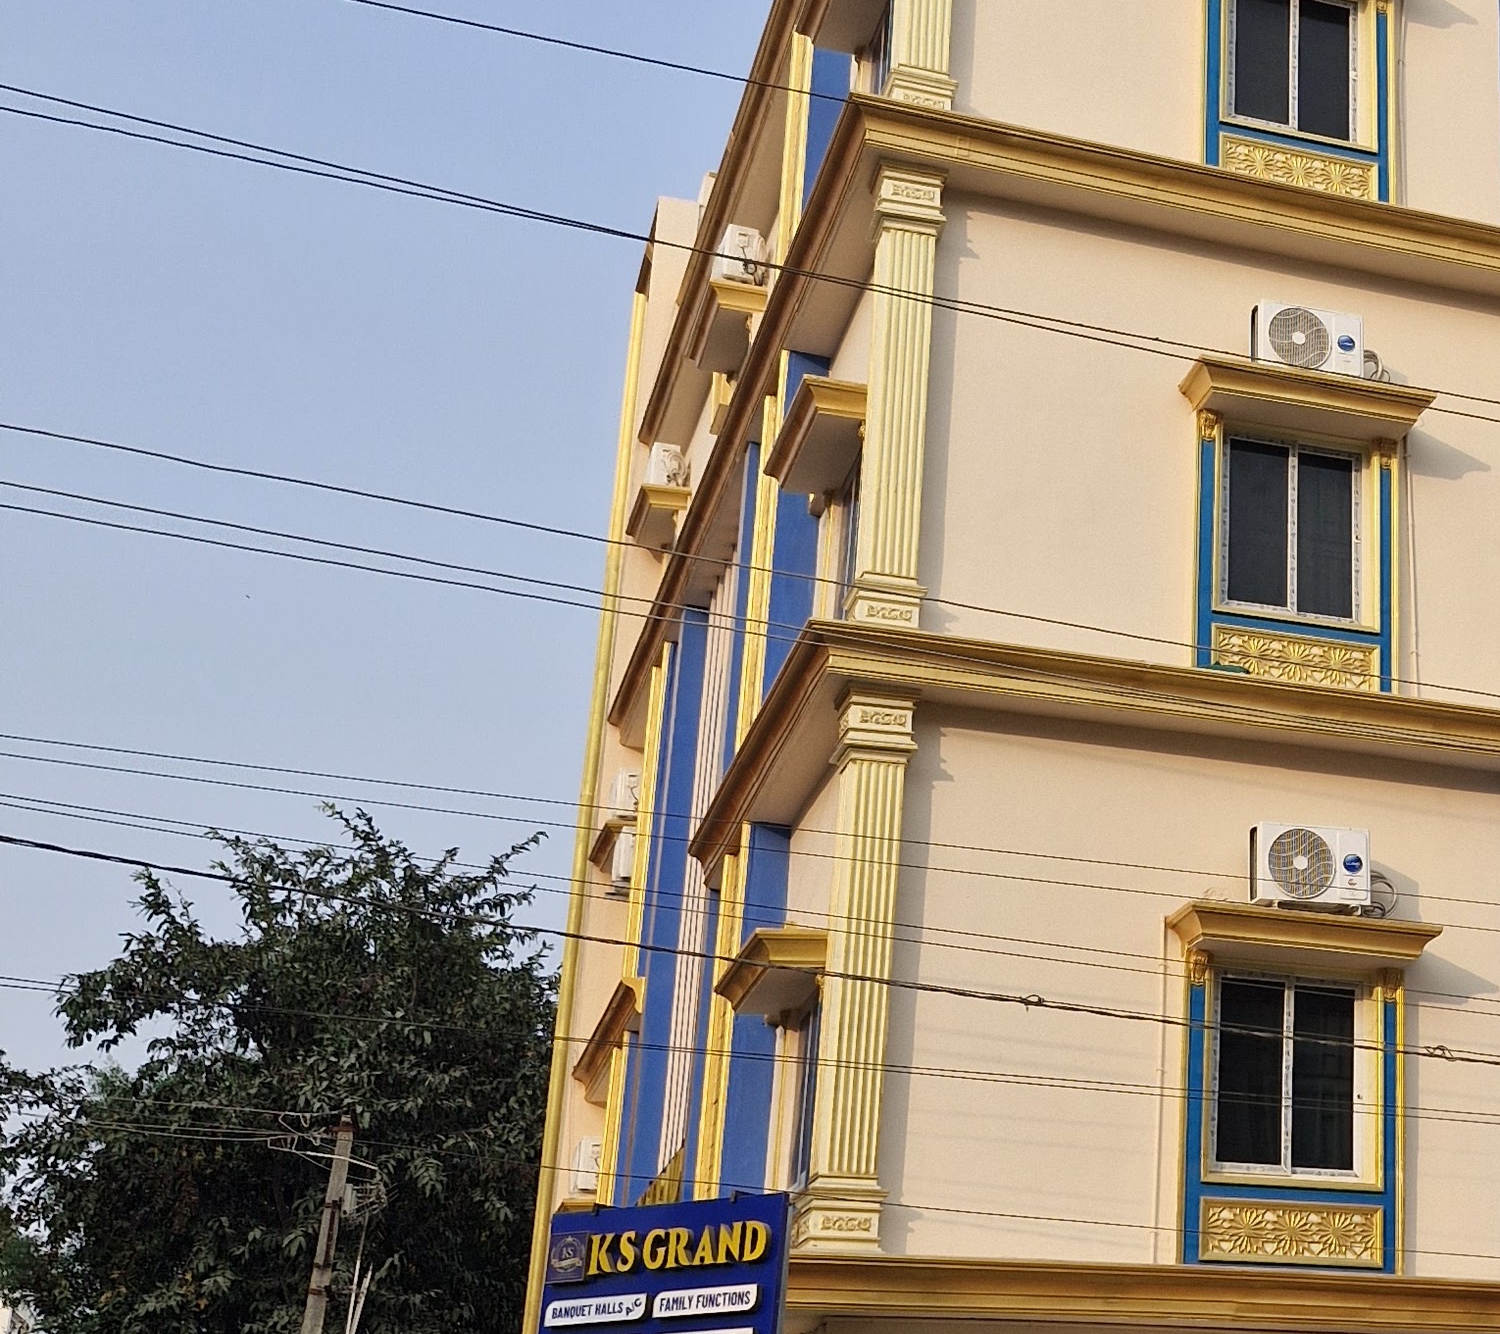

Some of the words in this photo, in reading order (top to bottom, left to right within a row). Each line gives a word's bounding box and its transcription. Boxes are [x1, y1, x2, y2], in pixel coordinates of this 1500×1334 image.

[643, 1220, 771, 1271] GRAND
[552, 1304, 593, 1319] BANQUET
[594, 1302, 624, 1316] HALLS
[625, 1298, 642, 1316] A/C
[660, 1295, 694, 1312] FAMILY
[696, 1290, 751, 1309] FUNCTIONS
